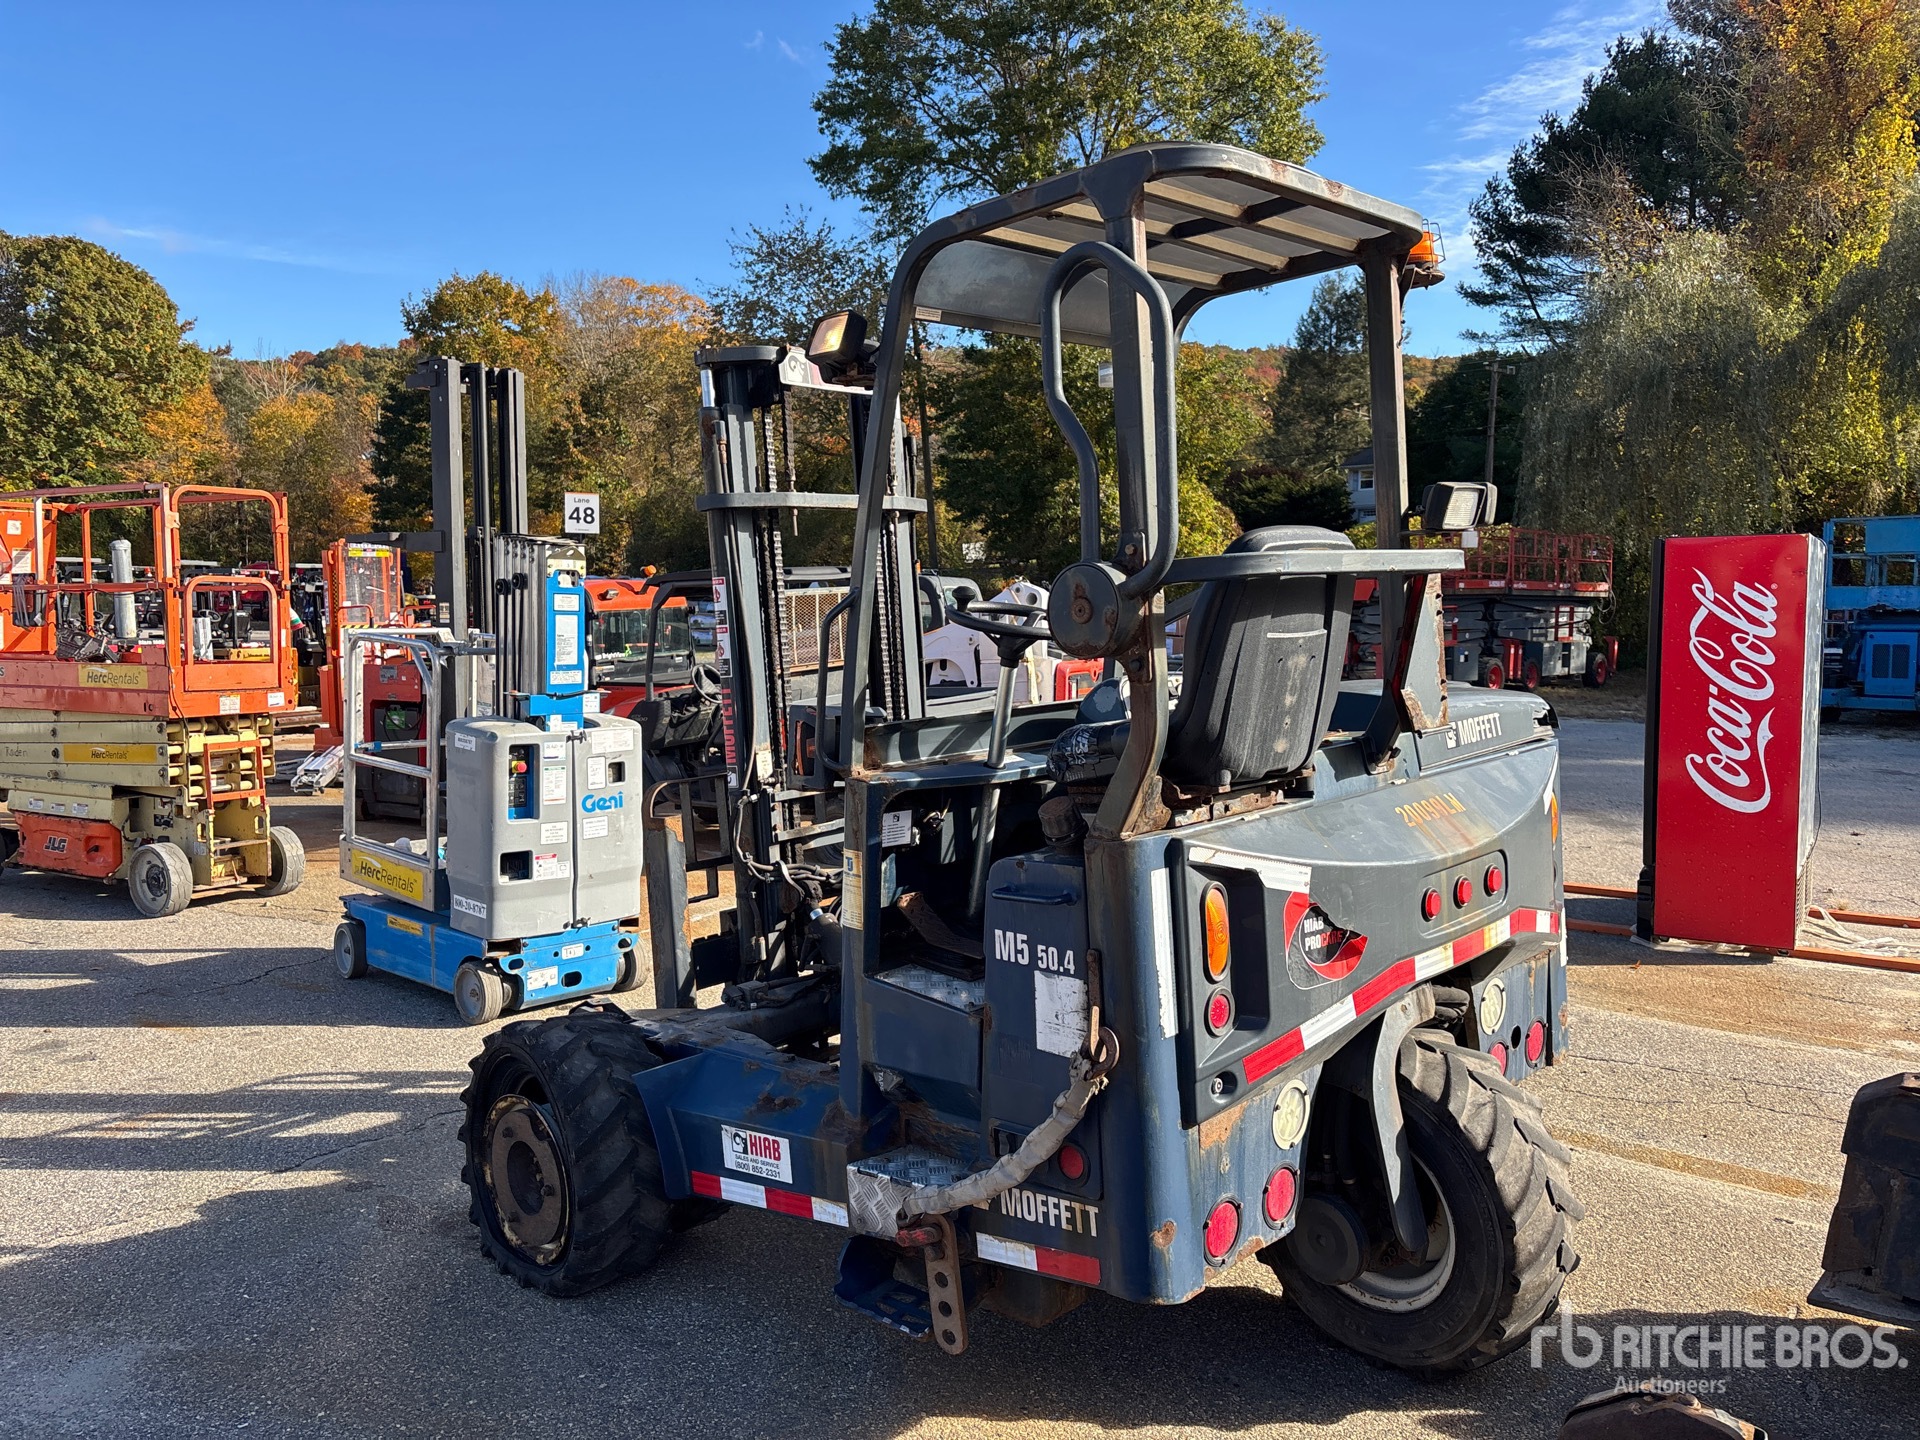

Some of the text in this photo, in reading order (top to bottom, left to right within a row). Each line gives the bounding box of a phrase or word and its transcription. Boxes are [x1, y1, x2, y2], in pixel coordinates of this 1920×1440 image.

[568, 506, 596, 525] 48
[86, 671, 139, 685] HercRentals
[1685, 566, 1778, 814] Coca-Cola
[1457, 712, 1502, 746] MOFFETT
[91, 750, 128, 760] HercRentals
[44, 836, 68, 853] JLG
[360, 861, 415, 893] HercRentals
[1303, 916, 1325, 934] HIAB
[1304, 930, 1344, 952] PROCARE
[994, 928, 1076, 975] M5 50.4
[749, 1134, 781, 1162] HIAB
[735, 1154, 780, 1170] SALES AND SERVICE
[735, 1160, 781, 1178] (800) 852-2331
[1000, 1187, 1099, 1238] MOFFETT
